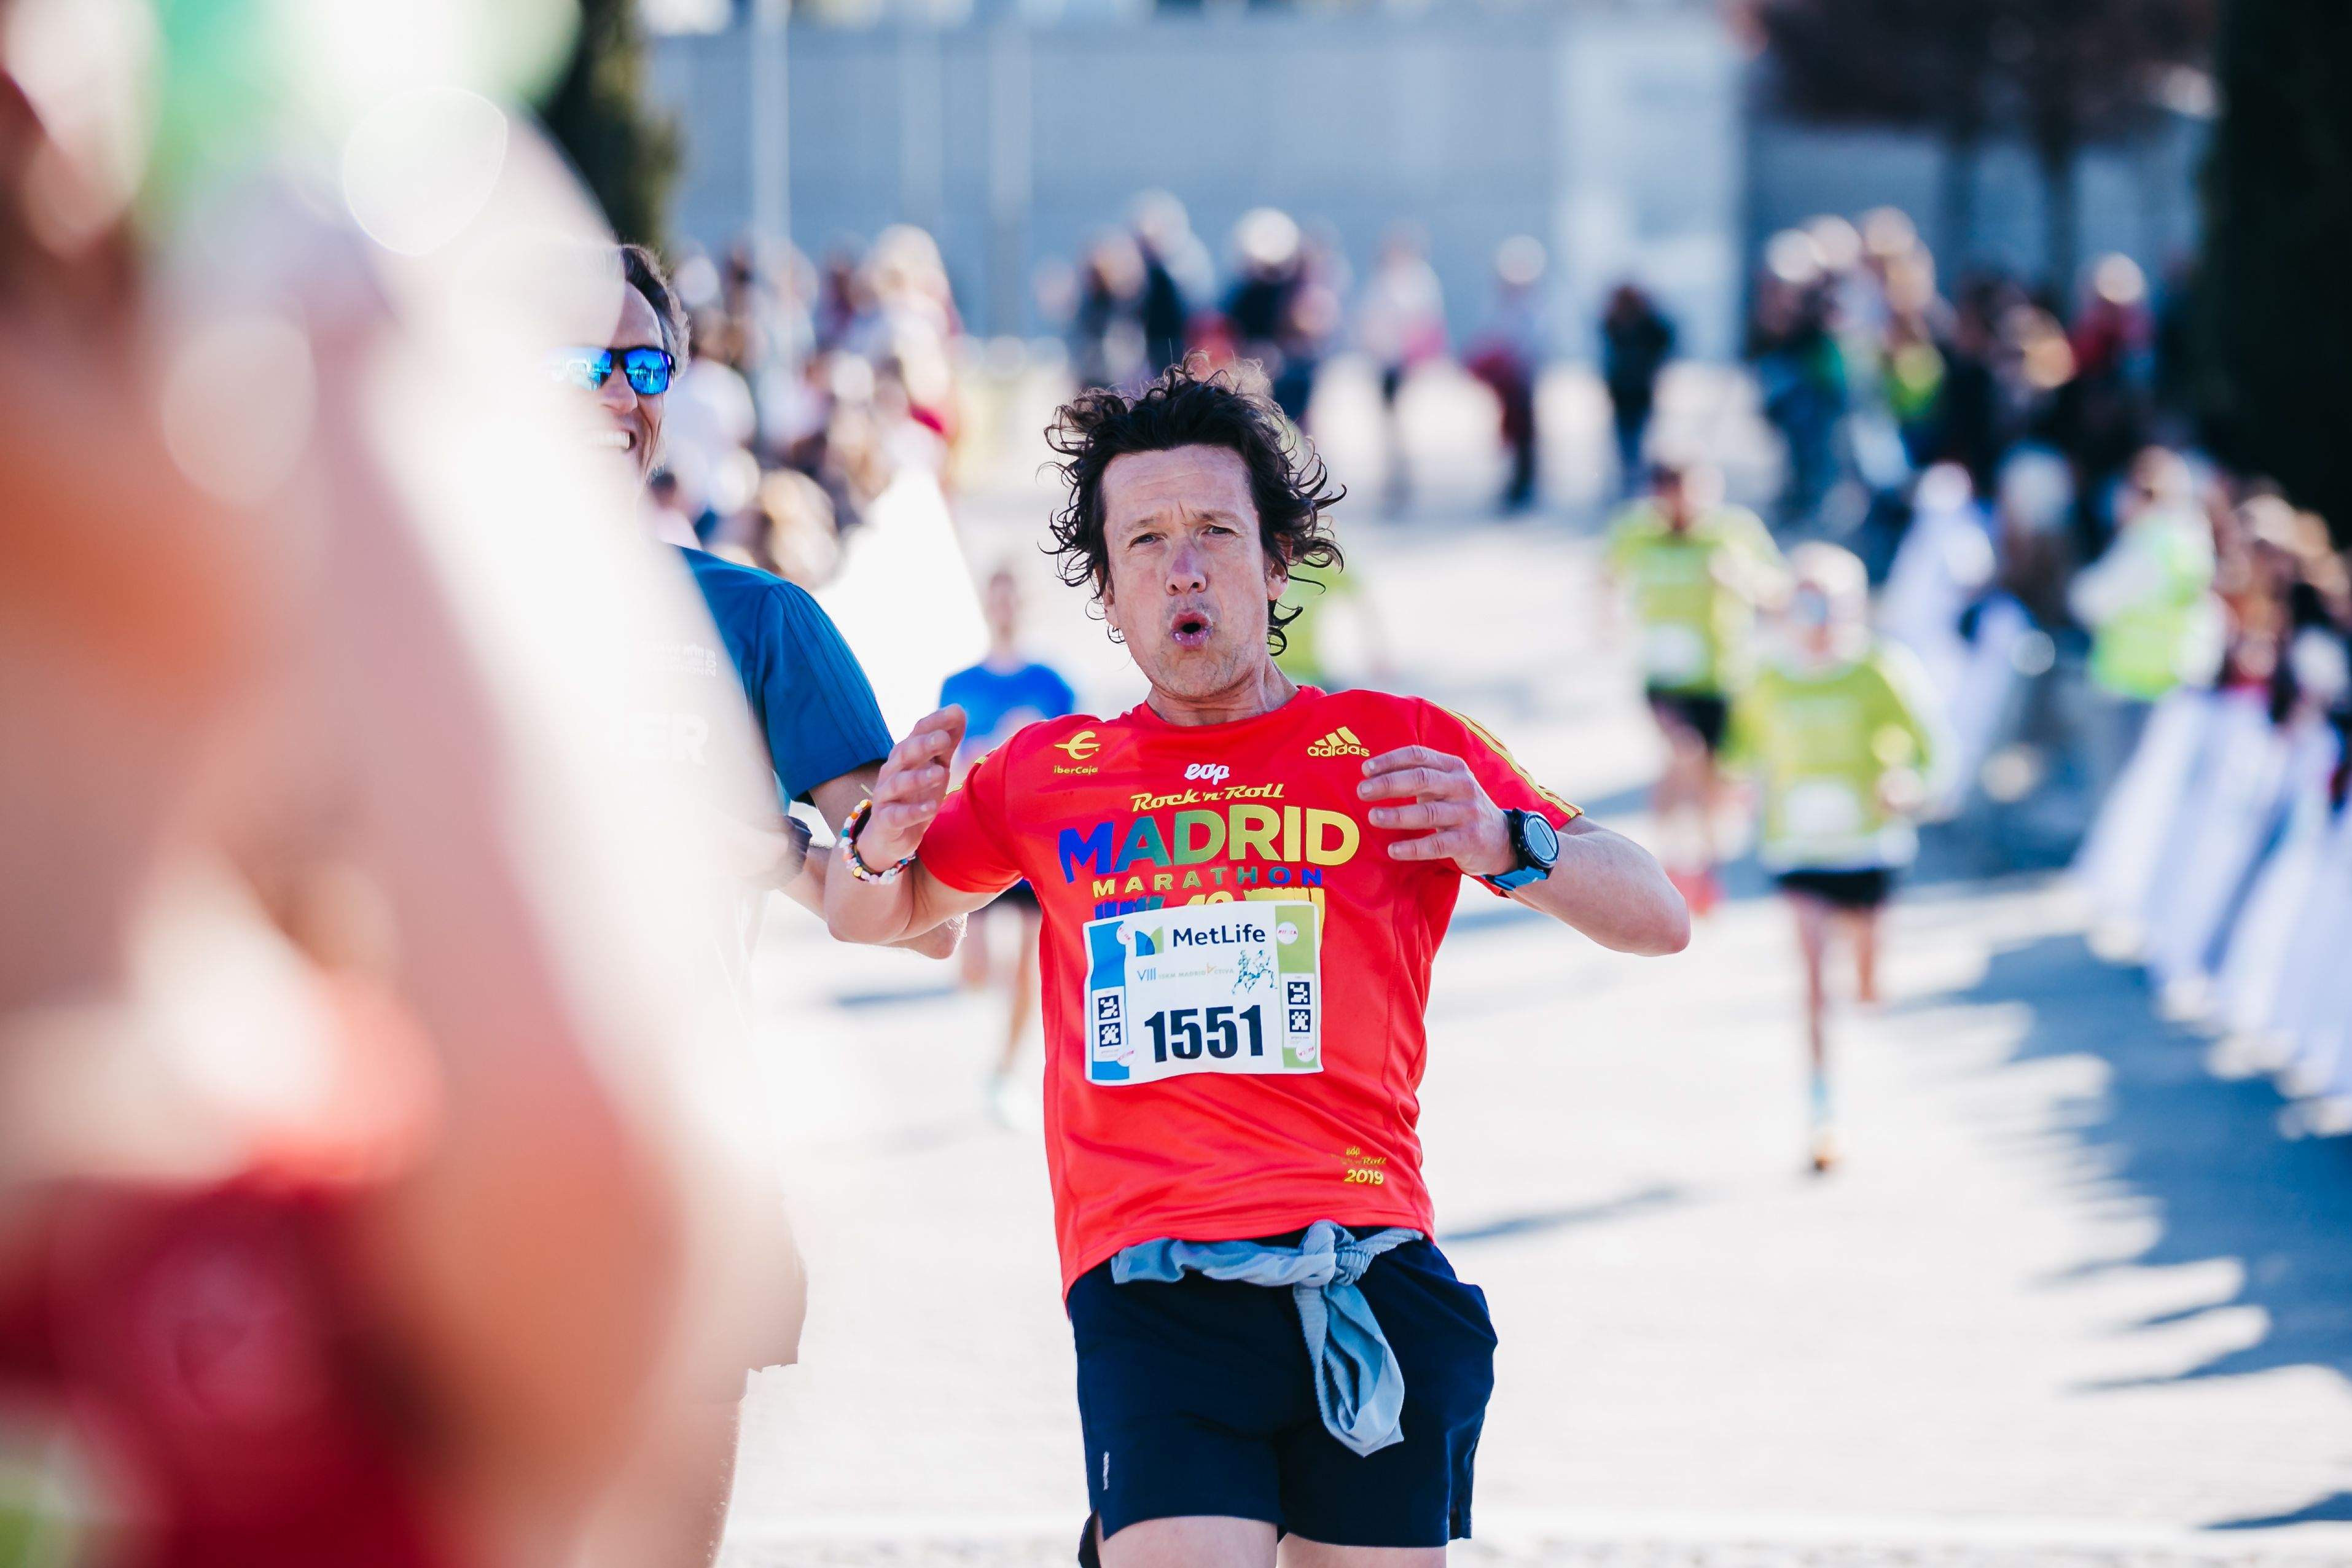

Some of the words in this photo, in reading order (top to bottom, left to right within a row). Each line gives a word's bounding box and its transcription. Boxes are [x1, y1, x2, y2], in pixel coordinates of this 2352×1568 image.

[1307, 744, 1370, 757] adidas
[1131, 789, 1201, 812] Rock
[1224, 783, 1284, 800] Roll
[1058, 805, 1359, 884] MADRID
[1093, 867, 1321, 897] MARATHON
[1173, 924, 1265, 947] MetLife
[1137, 967, 1156, 981] VIII
[1144, 1005, 1264, 1063] 1551
[1344, 1169, 1384, 1185] 2019
